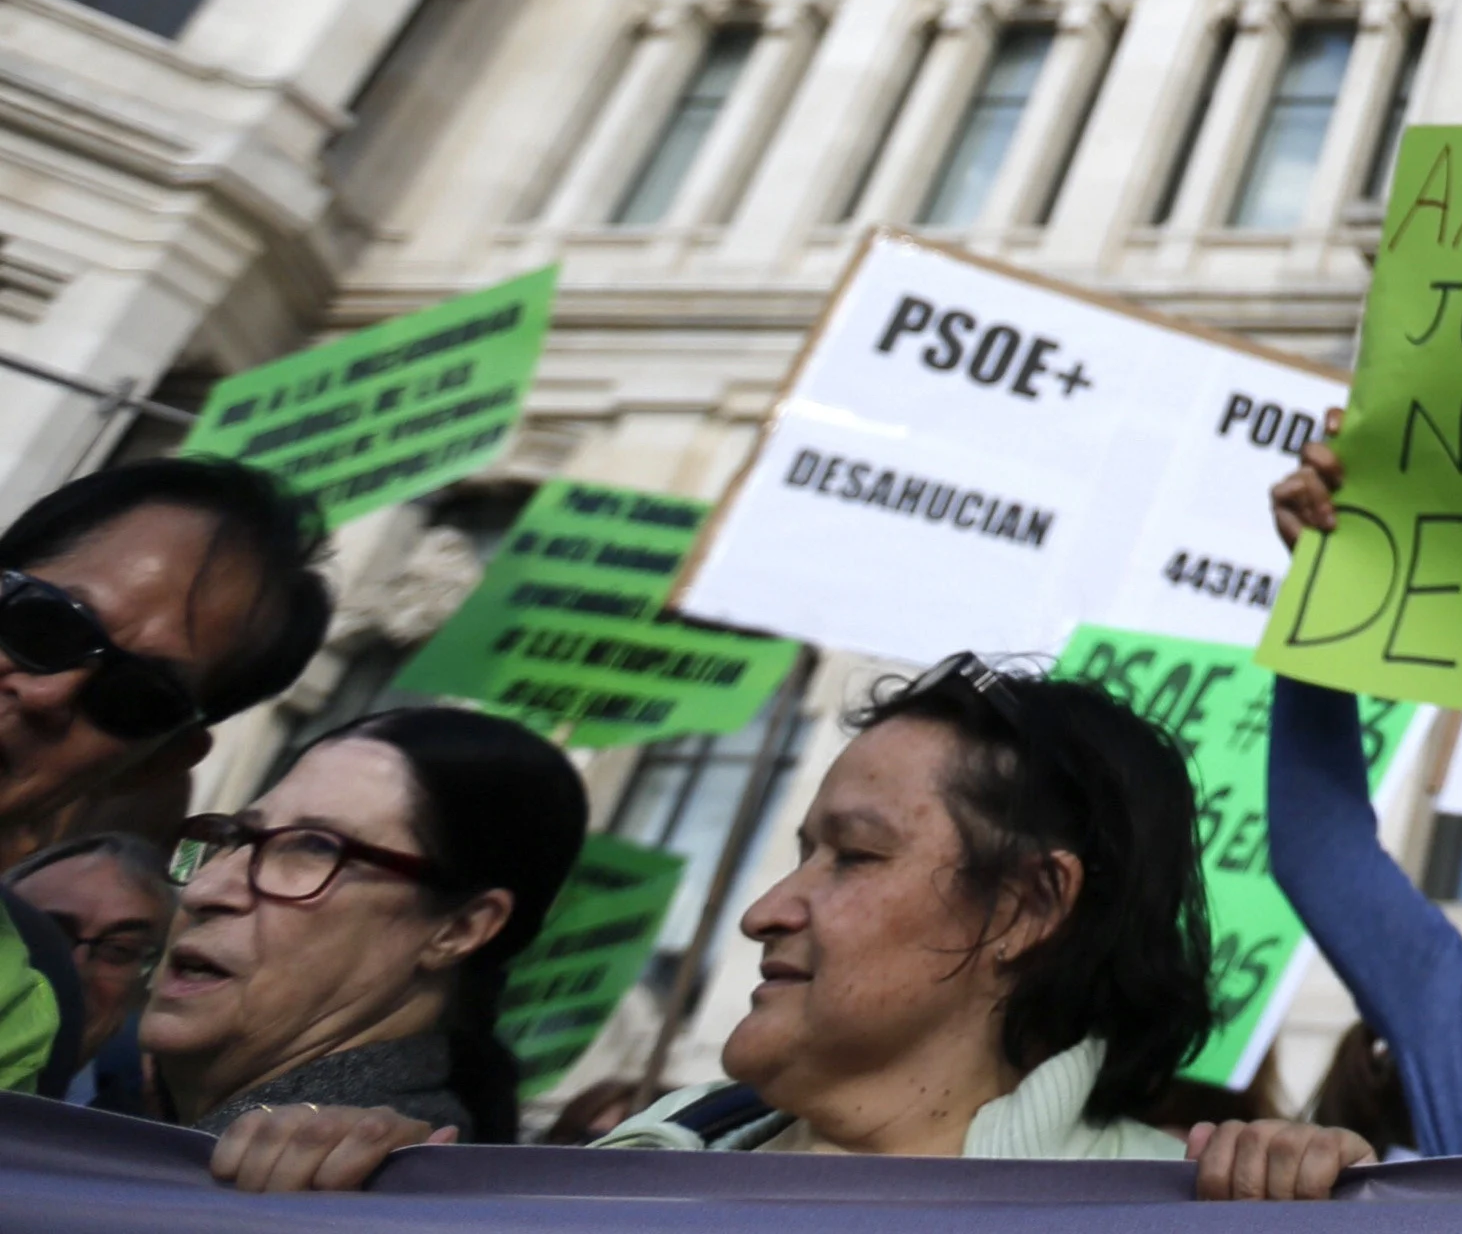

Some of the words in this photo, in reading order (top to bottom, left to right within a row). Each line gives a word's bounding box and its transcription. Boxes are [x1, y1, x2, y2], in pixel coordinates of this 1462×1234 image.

[874, 293, 1093, 404] PSOE+
[1216, 392, 1318, 456] POD
[784, 447, 1055, 549] DESAHUCIAN
[1165, 551, 1278, 609] 443FA
